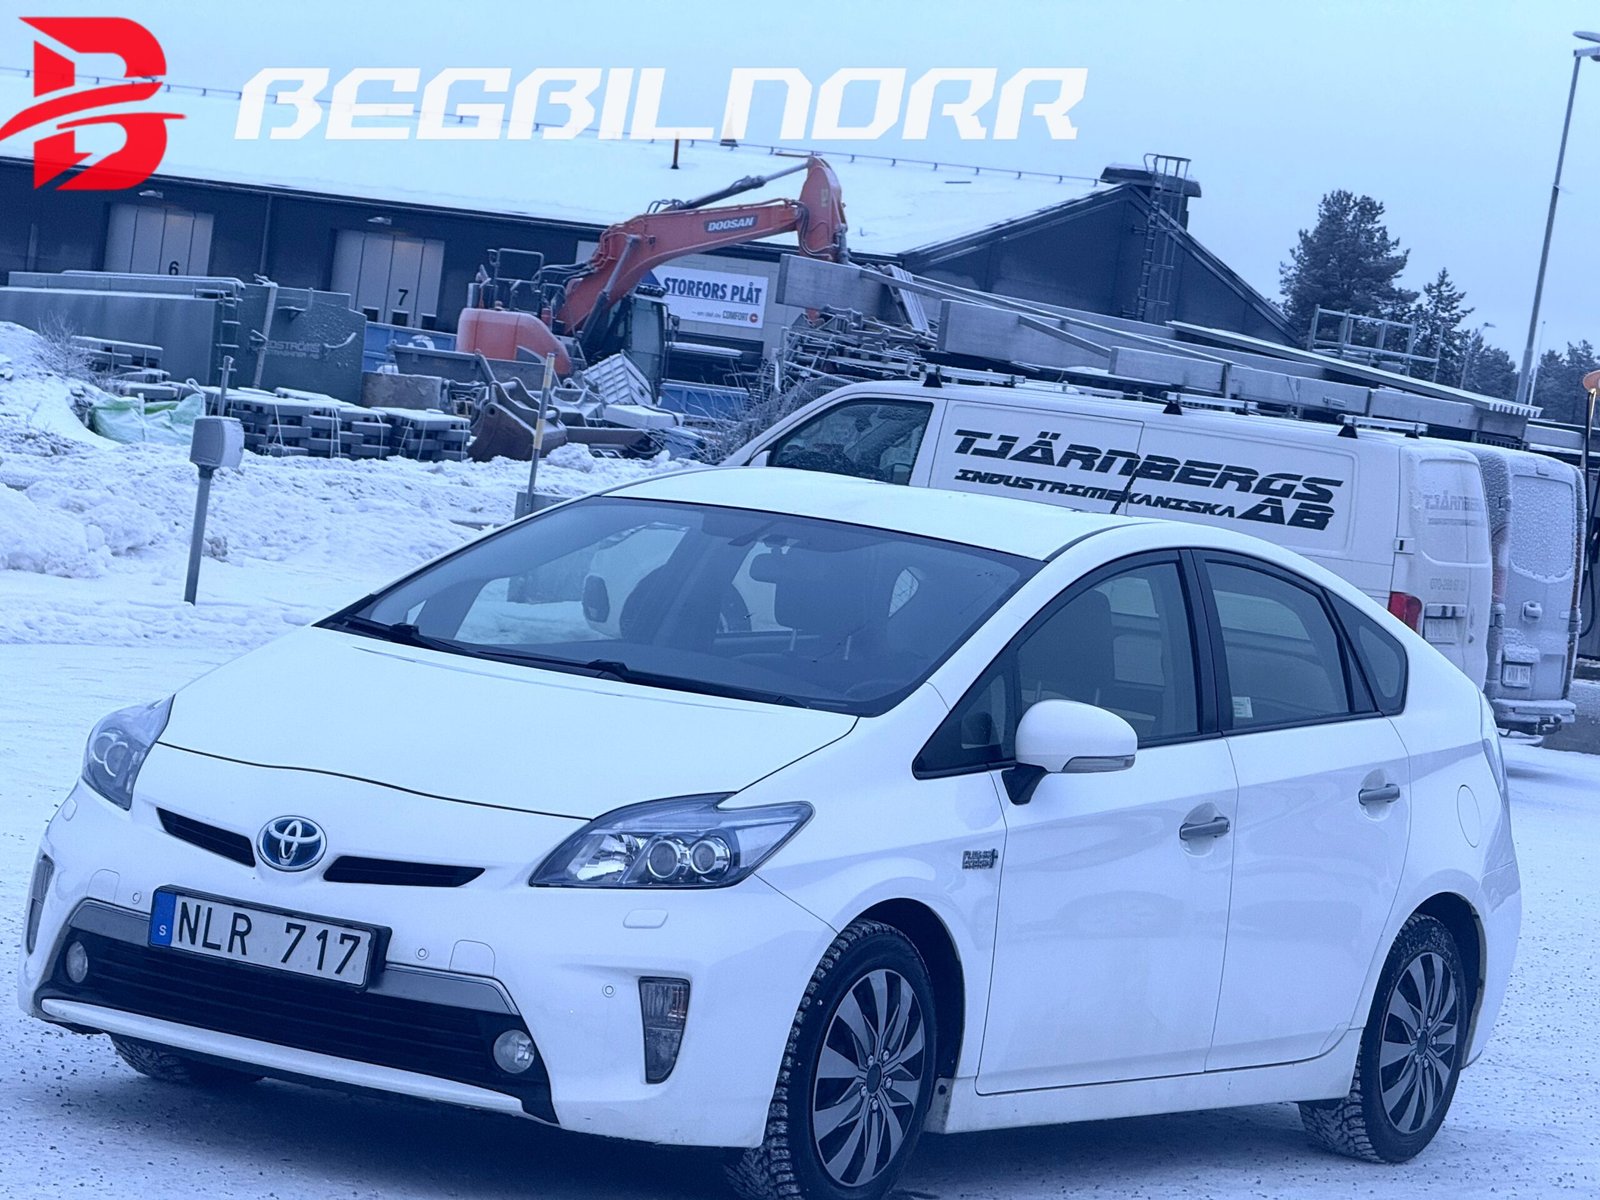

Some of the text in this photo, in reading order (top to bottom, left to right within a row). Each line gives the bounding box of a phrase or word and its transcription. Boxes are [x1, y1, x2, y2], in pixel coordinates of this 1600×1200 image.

[708, 217, 754, 231] DOOSAN
[168, 260, 179, 276] 6
[398, 288, 409, 306] 7
[664, 277, 762, 304] STORFORS PLÅT
[953, 429, 1344, 505] TJÄRNBERGS
[954, 468, 1336, 531] INDUSTRIMEKANISKA AB
[158, 925, 167, 936] S
[178, 901, 361, 975] NLR 717
